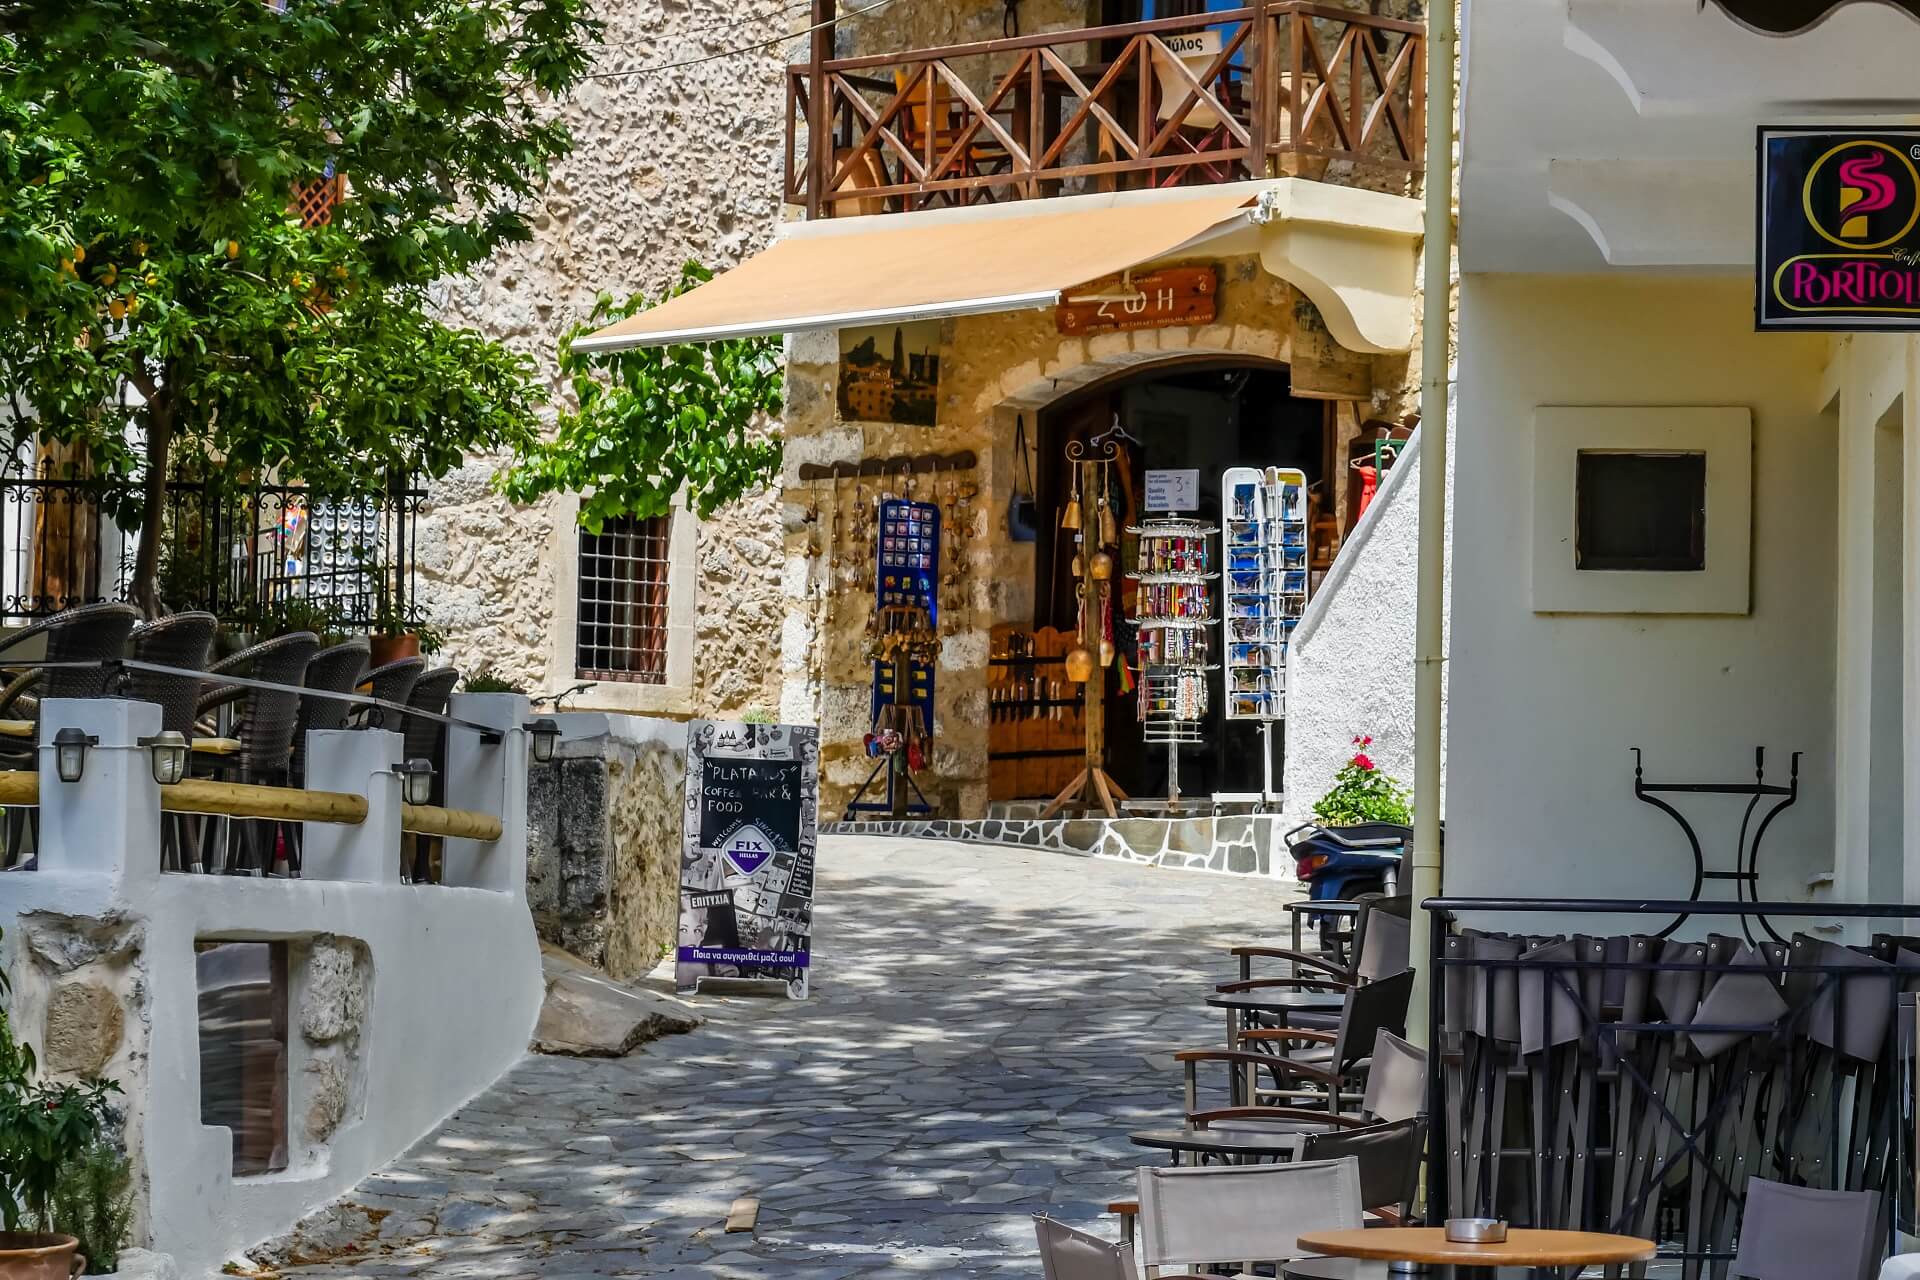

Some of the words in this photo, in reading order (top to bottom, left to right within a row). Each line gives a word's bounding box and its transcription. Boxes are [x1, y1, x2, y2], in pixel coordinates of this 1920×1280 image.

[704, 785, 742, 799] COFFE
[708, 800, 743, 813] FOOD
[735, 841, 763, 850] FIX
[691, 895, 730, 908] ΕΠΙΤΥΧΙΑ
[693, 949, 711, 959] Ποια
[712, 952, 722, 960] να
[760, 952, 778, 963] μαζί
